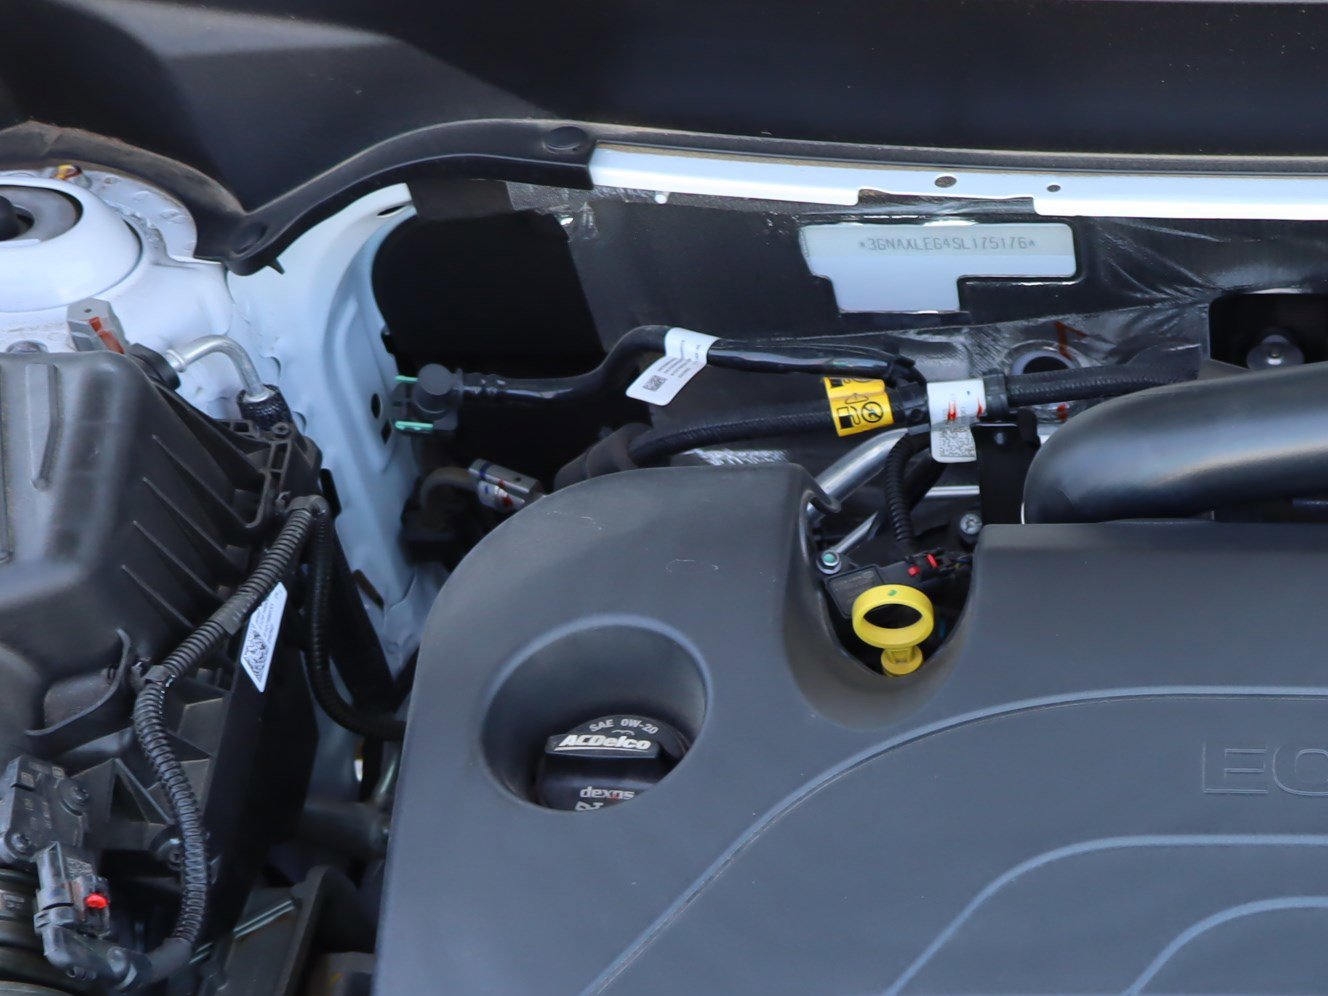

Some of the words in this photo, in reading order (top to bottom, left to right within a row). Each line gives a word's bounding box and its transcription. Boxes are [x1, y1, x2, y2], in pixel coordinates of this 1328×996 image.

[589, 718, 614, 732] SAE
[620, 718, 659, 735] 0W-20
[558, 734, 651, 750] ACDelco
[579, 785, 636, 800] dexos
